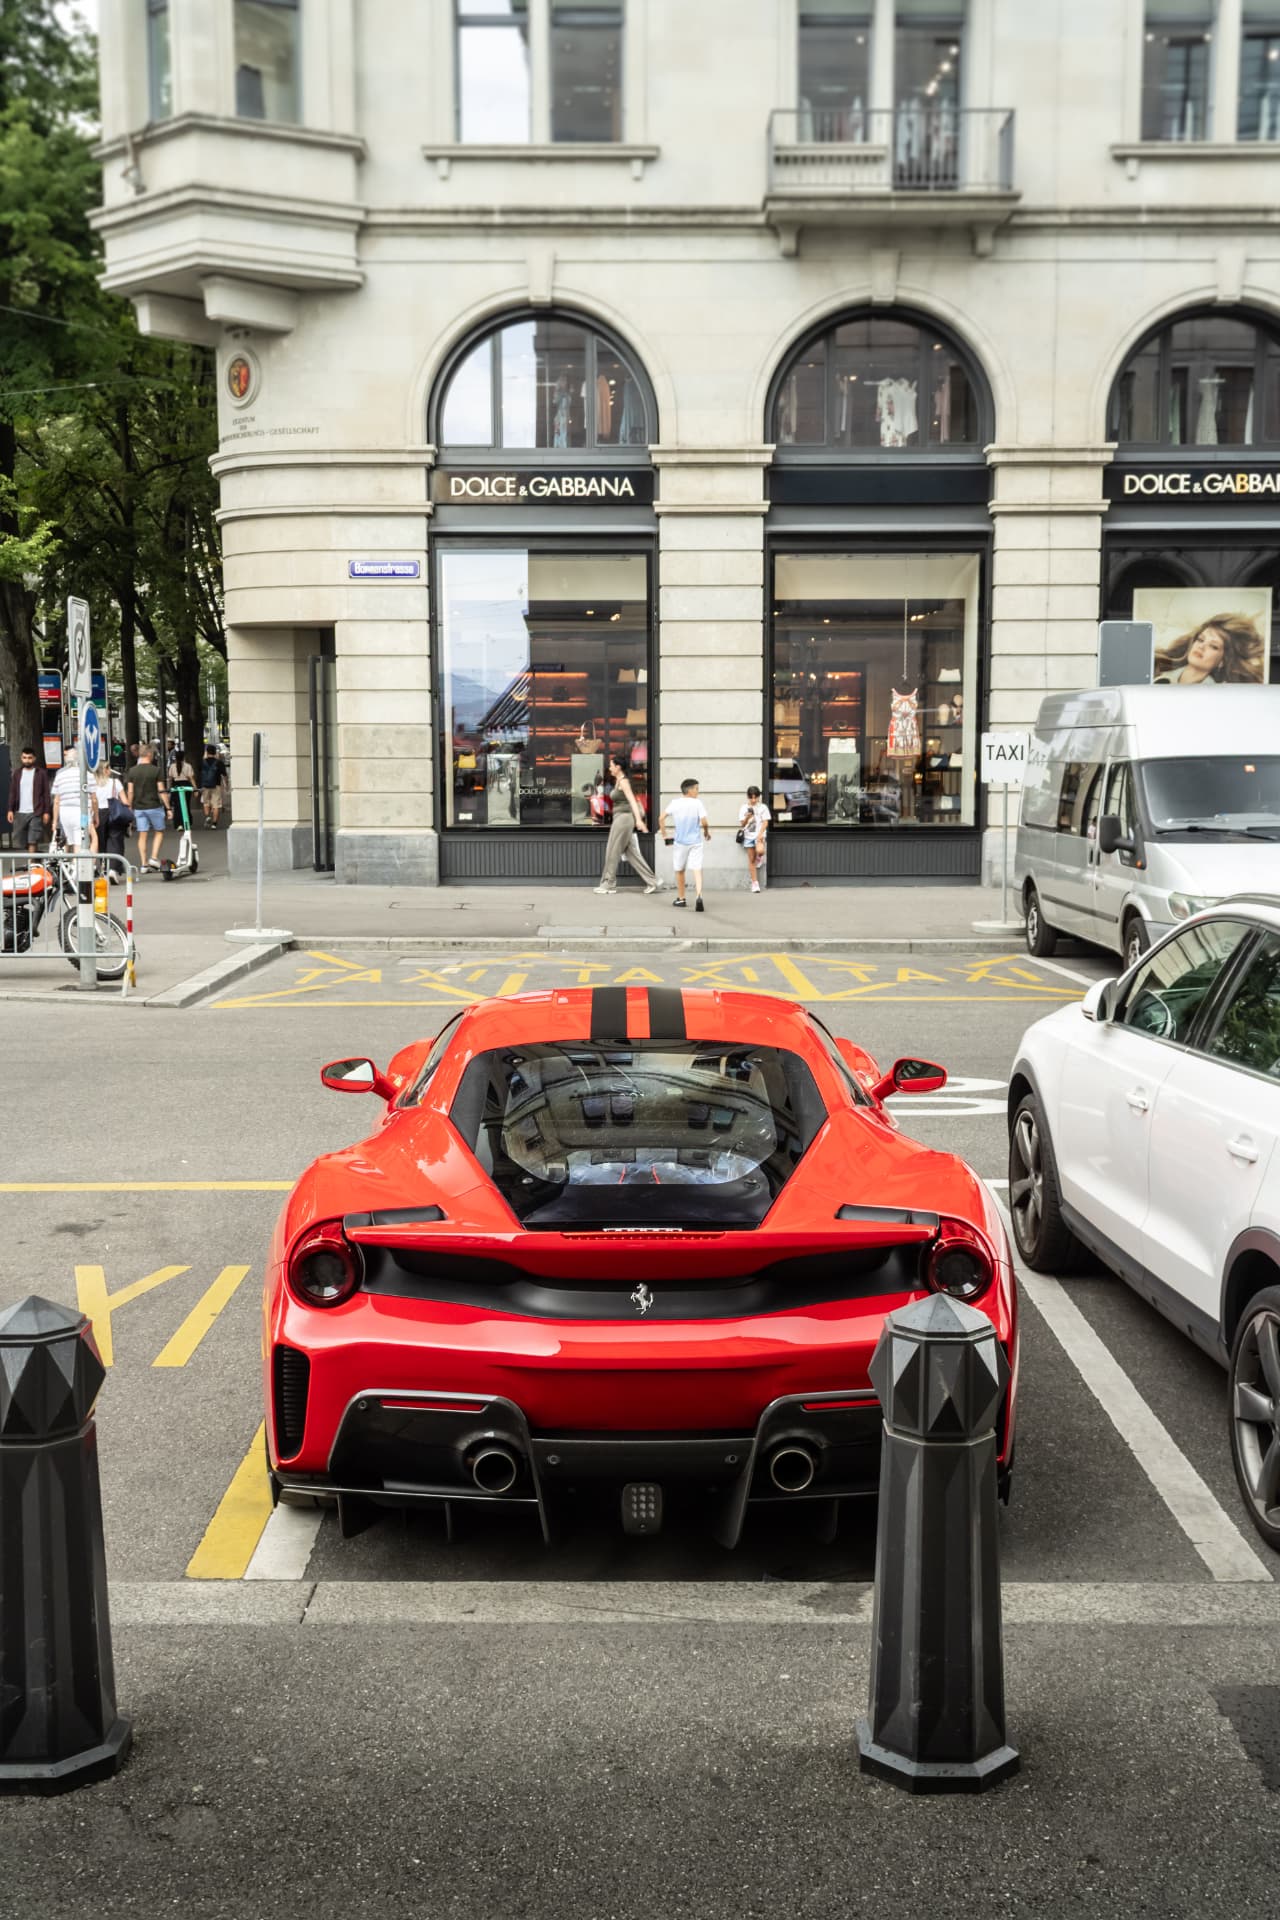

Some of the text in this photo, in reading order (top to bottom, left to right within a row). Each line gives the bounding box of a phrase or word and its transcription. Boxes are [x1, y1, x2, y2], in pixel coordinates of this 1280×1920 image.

[450, 477, 635, 497] DOLCE & GABBANA
[1124, 473, 1280, 494] DOLCE & GABBA
[985, 744, 1025, 761] TAXI
[561, 967, 760, 983] TAXI
[827, 967, 1044, 983] TAXI
